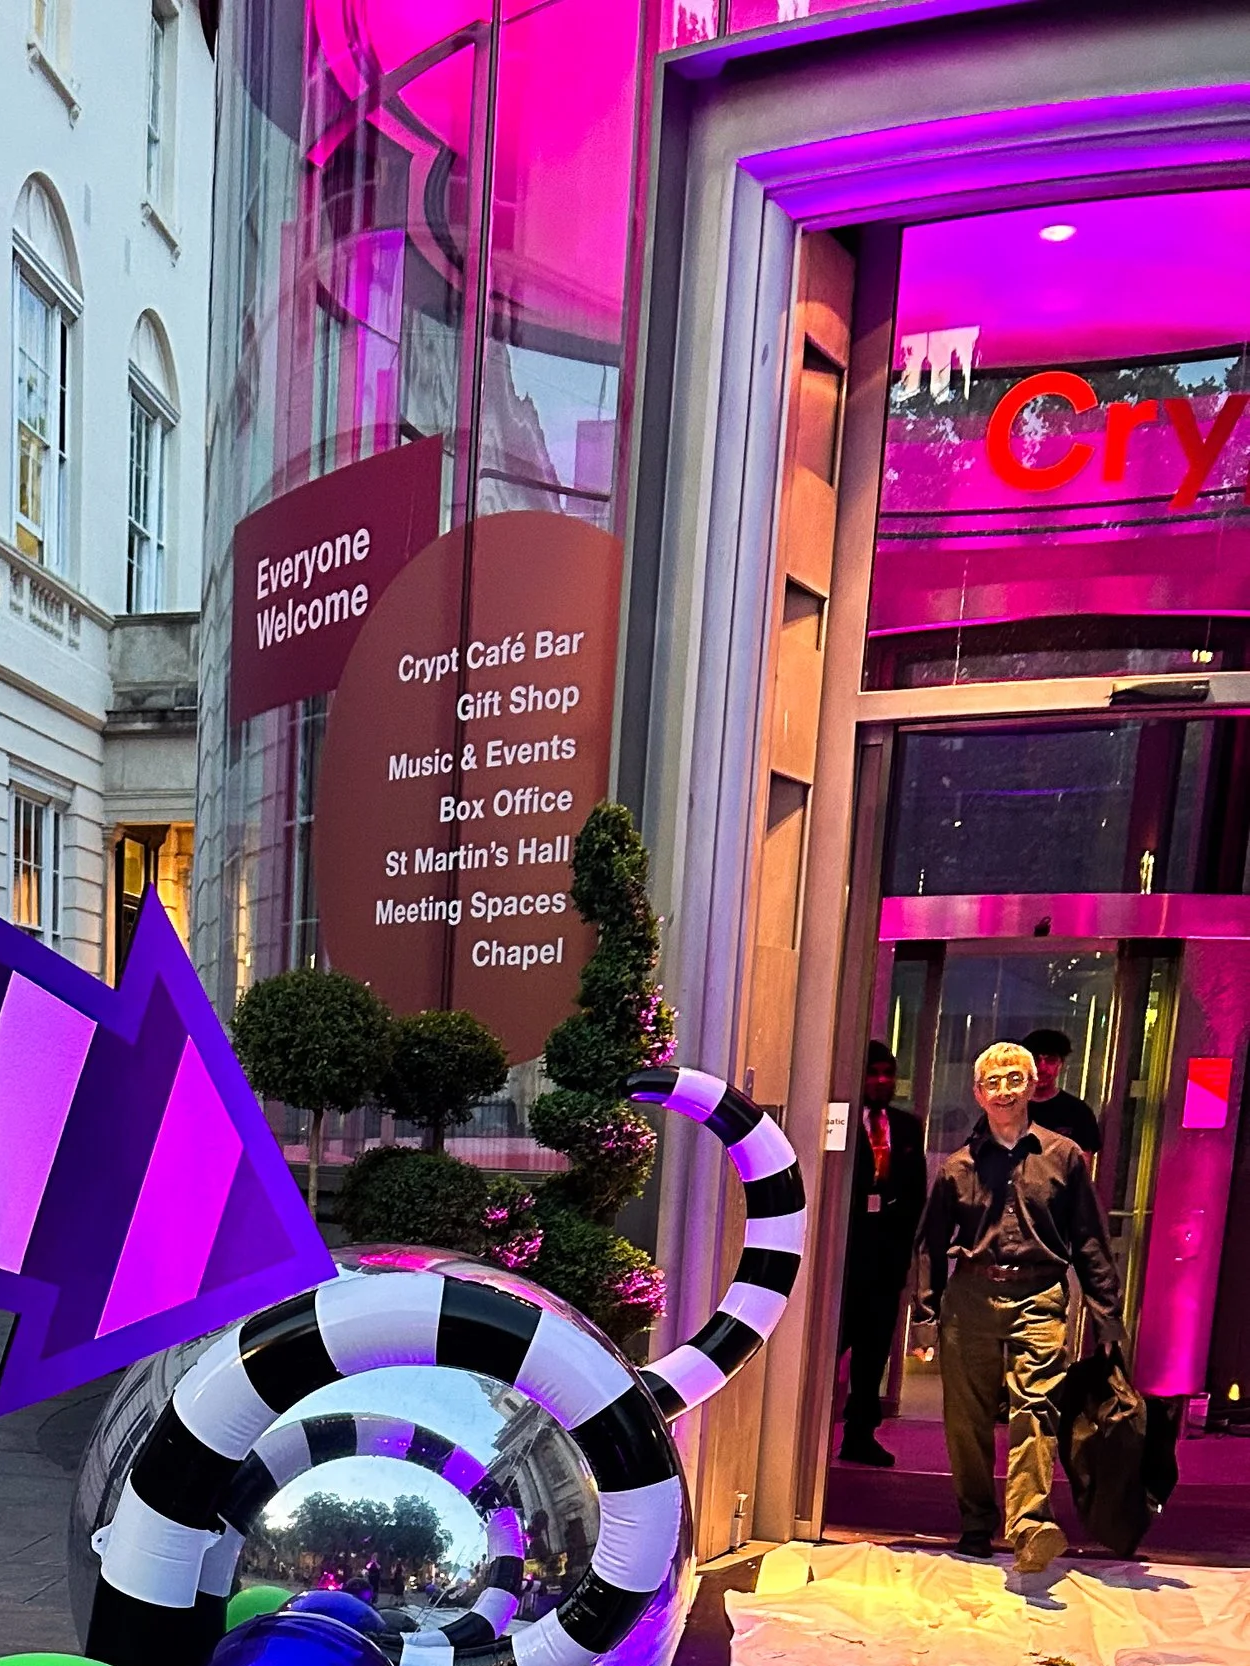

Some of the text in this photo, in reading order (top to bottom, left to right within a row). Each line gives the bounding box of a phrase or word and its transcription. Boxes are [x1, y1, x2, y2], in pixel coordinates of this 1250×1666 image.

[986, 369, 1250, 512] Cry
[256, 527, 371, 600] Everyone
[256, 582, 369, 651] Welcome
[398, 630, 585, 683] Crypt Café Bar
[456, 683, 580, 722] Gift Shop
[388, 733, 577, 781] Music & Events
[439, 787, 574, 823] Box Office
[385, 849, 408, 877] St
[517, 834, 571, 865] Hall
[375, 892, 567, 926] Meeting Spaces
[471, 936, 564, 971] Chapel
